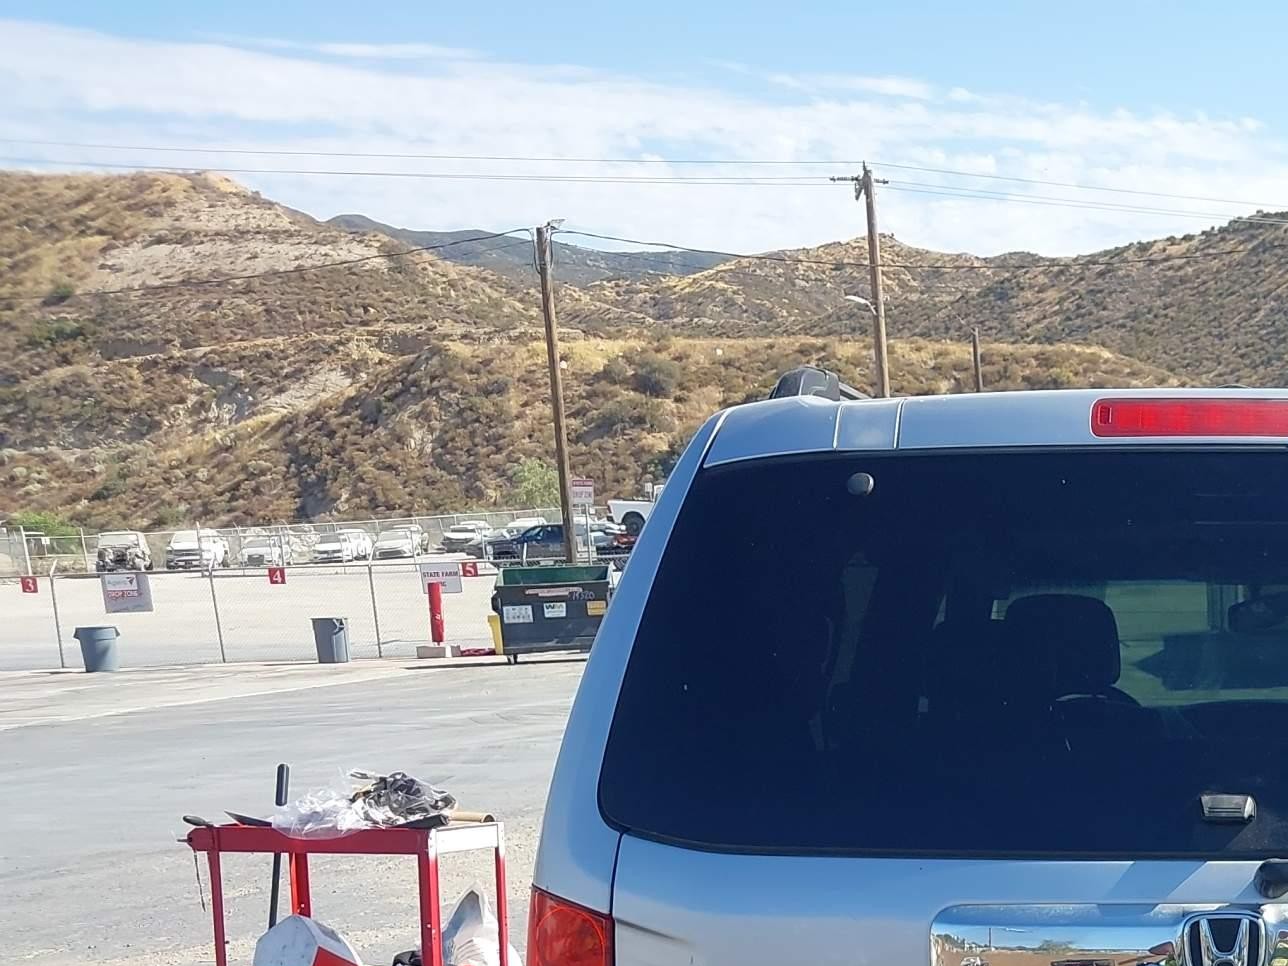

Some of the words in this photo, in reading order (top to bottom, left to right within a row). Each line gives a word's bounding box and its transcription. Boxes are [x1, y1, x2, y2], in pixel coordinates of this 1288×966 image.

[272, 569, 283, 584] 4
[465, 562, 475, 576] 5
[24, 578, 35, 593] 3
